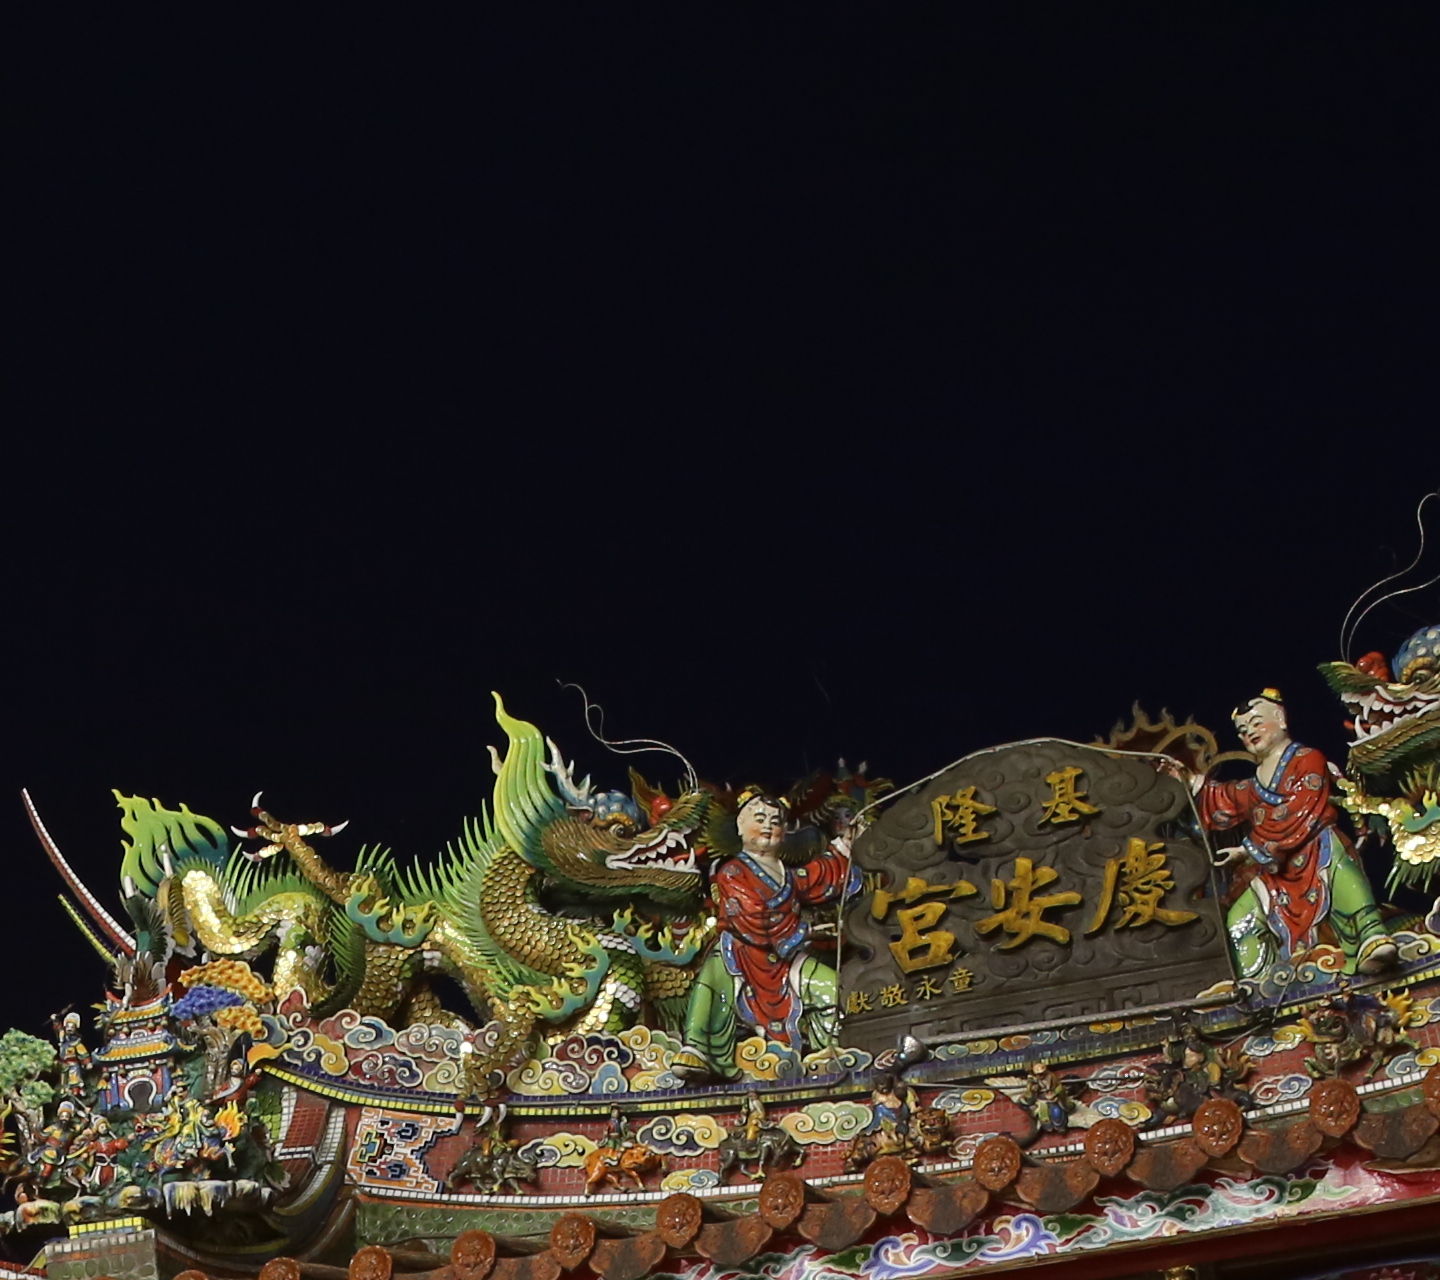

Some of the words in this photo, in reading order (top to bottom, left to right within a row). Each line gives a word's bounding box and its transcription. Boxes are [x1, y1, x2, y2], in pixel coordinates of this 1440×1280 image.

[930, 765, 1101, 848] 基隆
[870, 837, 1201, 976] 慶安宮
